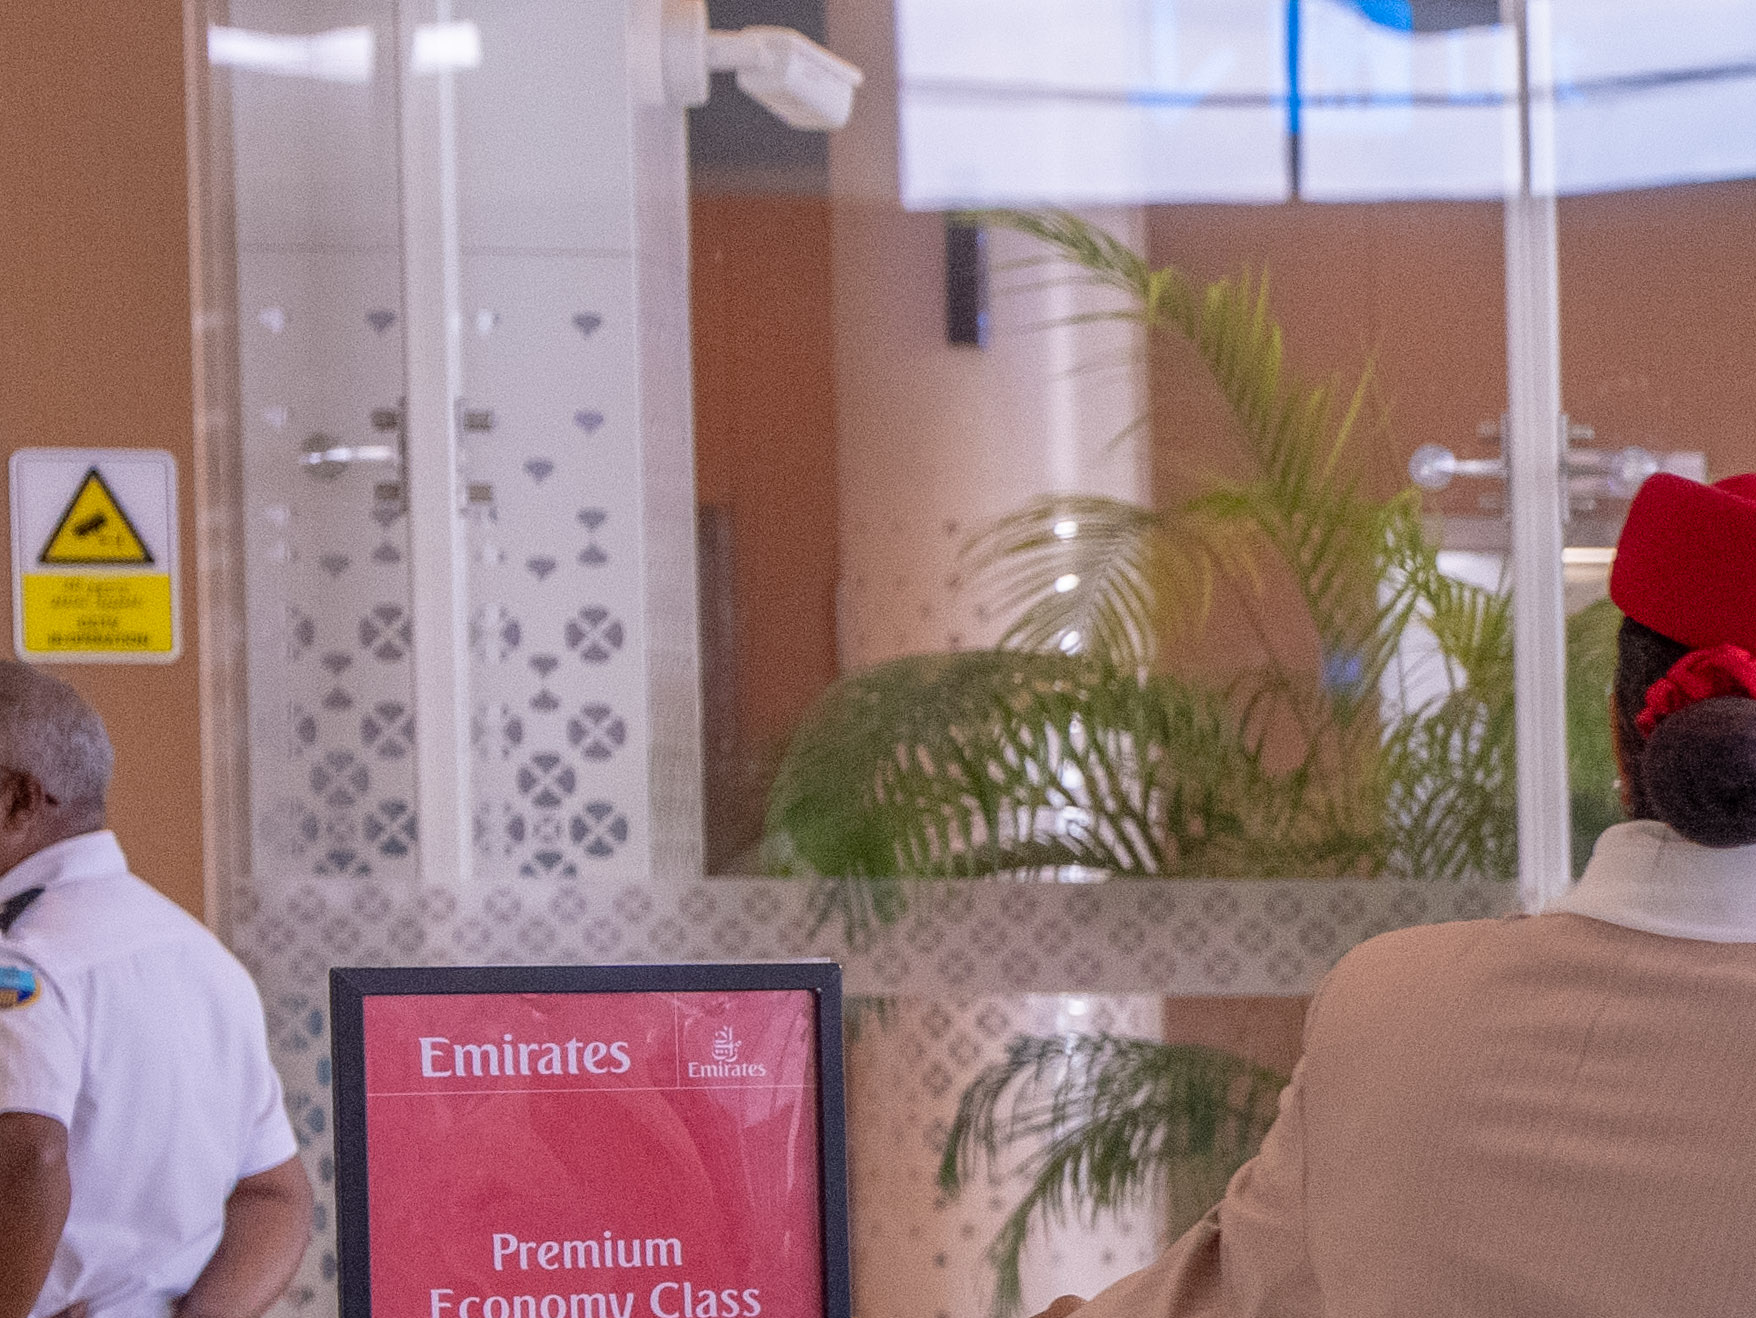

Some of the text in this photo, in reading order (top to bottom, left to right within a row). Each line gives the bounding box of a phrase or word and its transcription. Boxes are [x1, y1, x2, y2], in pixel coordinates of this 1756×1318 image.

[419, 1032, 632, 1078] Emirates
[688, 1060, 768, 1078] Emirates
[491, 1229, 684, 1272] Premium
